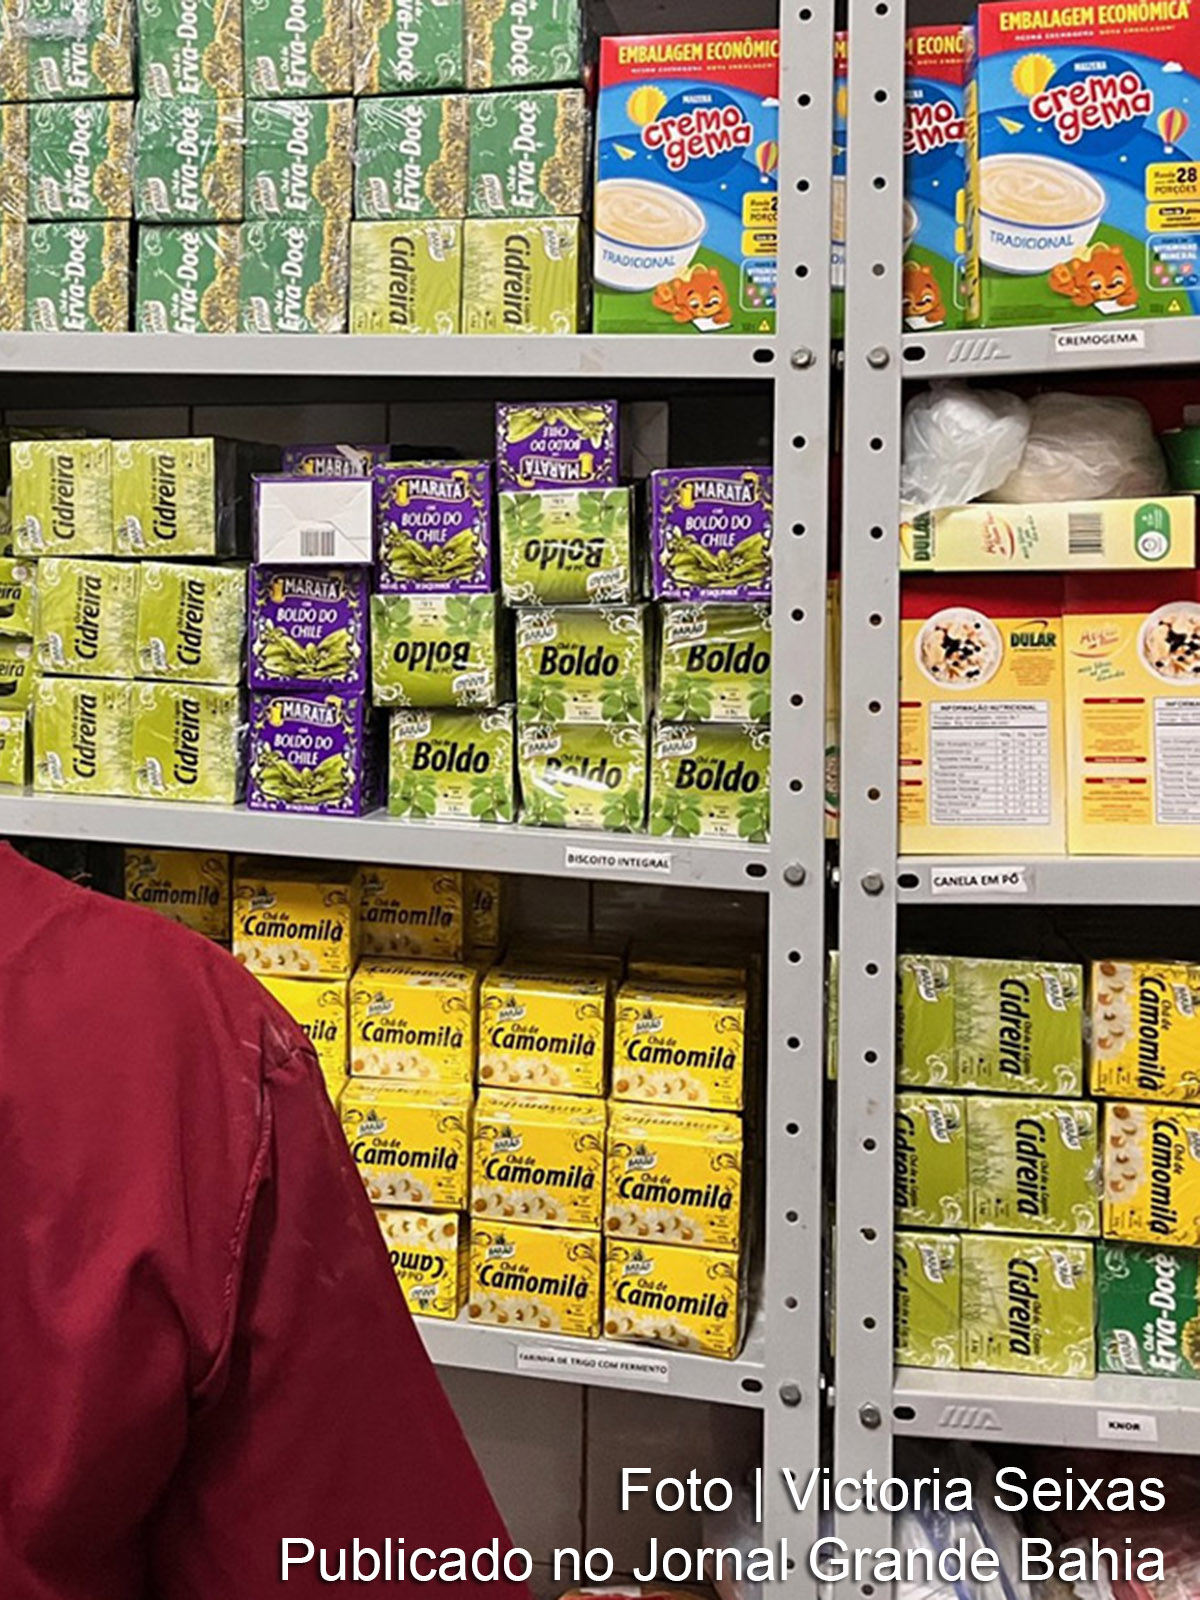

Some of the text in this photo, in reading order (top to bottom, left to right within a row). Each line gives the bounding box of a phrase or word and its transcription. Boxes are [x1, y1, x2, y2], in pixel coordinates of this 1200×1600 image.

[1000, 7, 1094, 31] EMBALAGEM
[619, 37, 779, 64] EMBALAGEM ECONÔMIC
[1031, 73, 1140, 118] cremo
[644, 108, 740, 146] cremo
[1058, 91, 1151, 142] gema
[69, 106, 93, 210] Erva-Doce
[176, 106, 200, 211] Erva-Doce
[285, 102, 314, 211] Erva-Doce
[397, 104, 425, 211] Erva-Doce
[512, 100, 541, 209] Erva-Doce
[667, 126, 751, 169] gema
[1177, 168, 1197, 183] 28
[989, 230, 1074, 250] TRADICIONAL
[603, 250, 676, 269] TRADICIONAL
[65, 228, 87, 330] Erva-Doce
[176, 231, 199, 333] Erva-Doce
[277, 227, 308, 332] Erva-Doce
[389, 235, 414, 326] Cidreira
[503, 235, 529, 326] Cidreira
[1058, 333, 1138, 346] CREMOGEMA
[52, 455, 75, 539] Cidreira
[153, 455, 176, 539] Cidreira
[401, 511, 462, 526] BOLDO DO
[415, 528, 448, 542] CHILE
[685, 515, 752, 530] BOLDO DO
[701, 532, 736, 548] CHILE
[75, 576, 103, 659] Cidreira
[177, 580, 205, 665] Cidreira
[277, 608, 337, 623] BOLDO DO
[290, 625, 322, 639] CHILE
[394, 641, 470, 673] Boldo
[1010, 632, 1056, 647] DULAR
[540, 646, 619, 677] Boldo
[687, 642, 770, 674] Boldo
[73, 694, 97, 778] Cidreira
[174, 699, 200, 785] Cidreira
[274, 734, 333, 750] BOLDO DO
[288, 751, 318, 765] CHILE
[412, 741, 489, 773] Boldo
[675, 758, 760, 793] Boldo
[568, 854, 670, 869] BISCOITO INTEGRAL
[933, 872, 1020, 888] CANELA EM PÓ
[244, 915, 343, 942] Camomila
[362, 1021, 462, 1048] Camomila
[491, 1027, 596, 1057] Camomila
[999, 978, 1030, 1077] Cidreira
[1138, 976, 1166, 1092] Camomila
[628, 1039, 736, 1070] Camomila
[353, 1140, 459, 1171] Camomila
[1014, 1117, 1047, 1218] Cidreira
[486, 1157, 596, 1190] Camomila
[1151, 1120, 1178, 1236] Camomila
[619, 1175, 733, 1211] Camomila
[480, 1263, 589, 1299] Camomila
[616, 1281, 729, 1319] Camomila
[1008, 1257, 1040, 1357] Cidreira
[1149, 1254, 1180, 1372] Erva-Doce
[571, 1359, 596, 1368] TRIGO
[598, 1361, 618, 1369] COM
[620, 1363, 668, 1374] FERMENTO
[1108, 1421, 1140, 1432] KNOR
